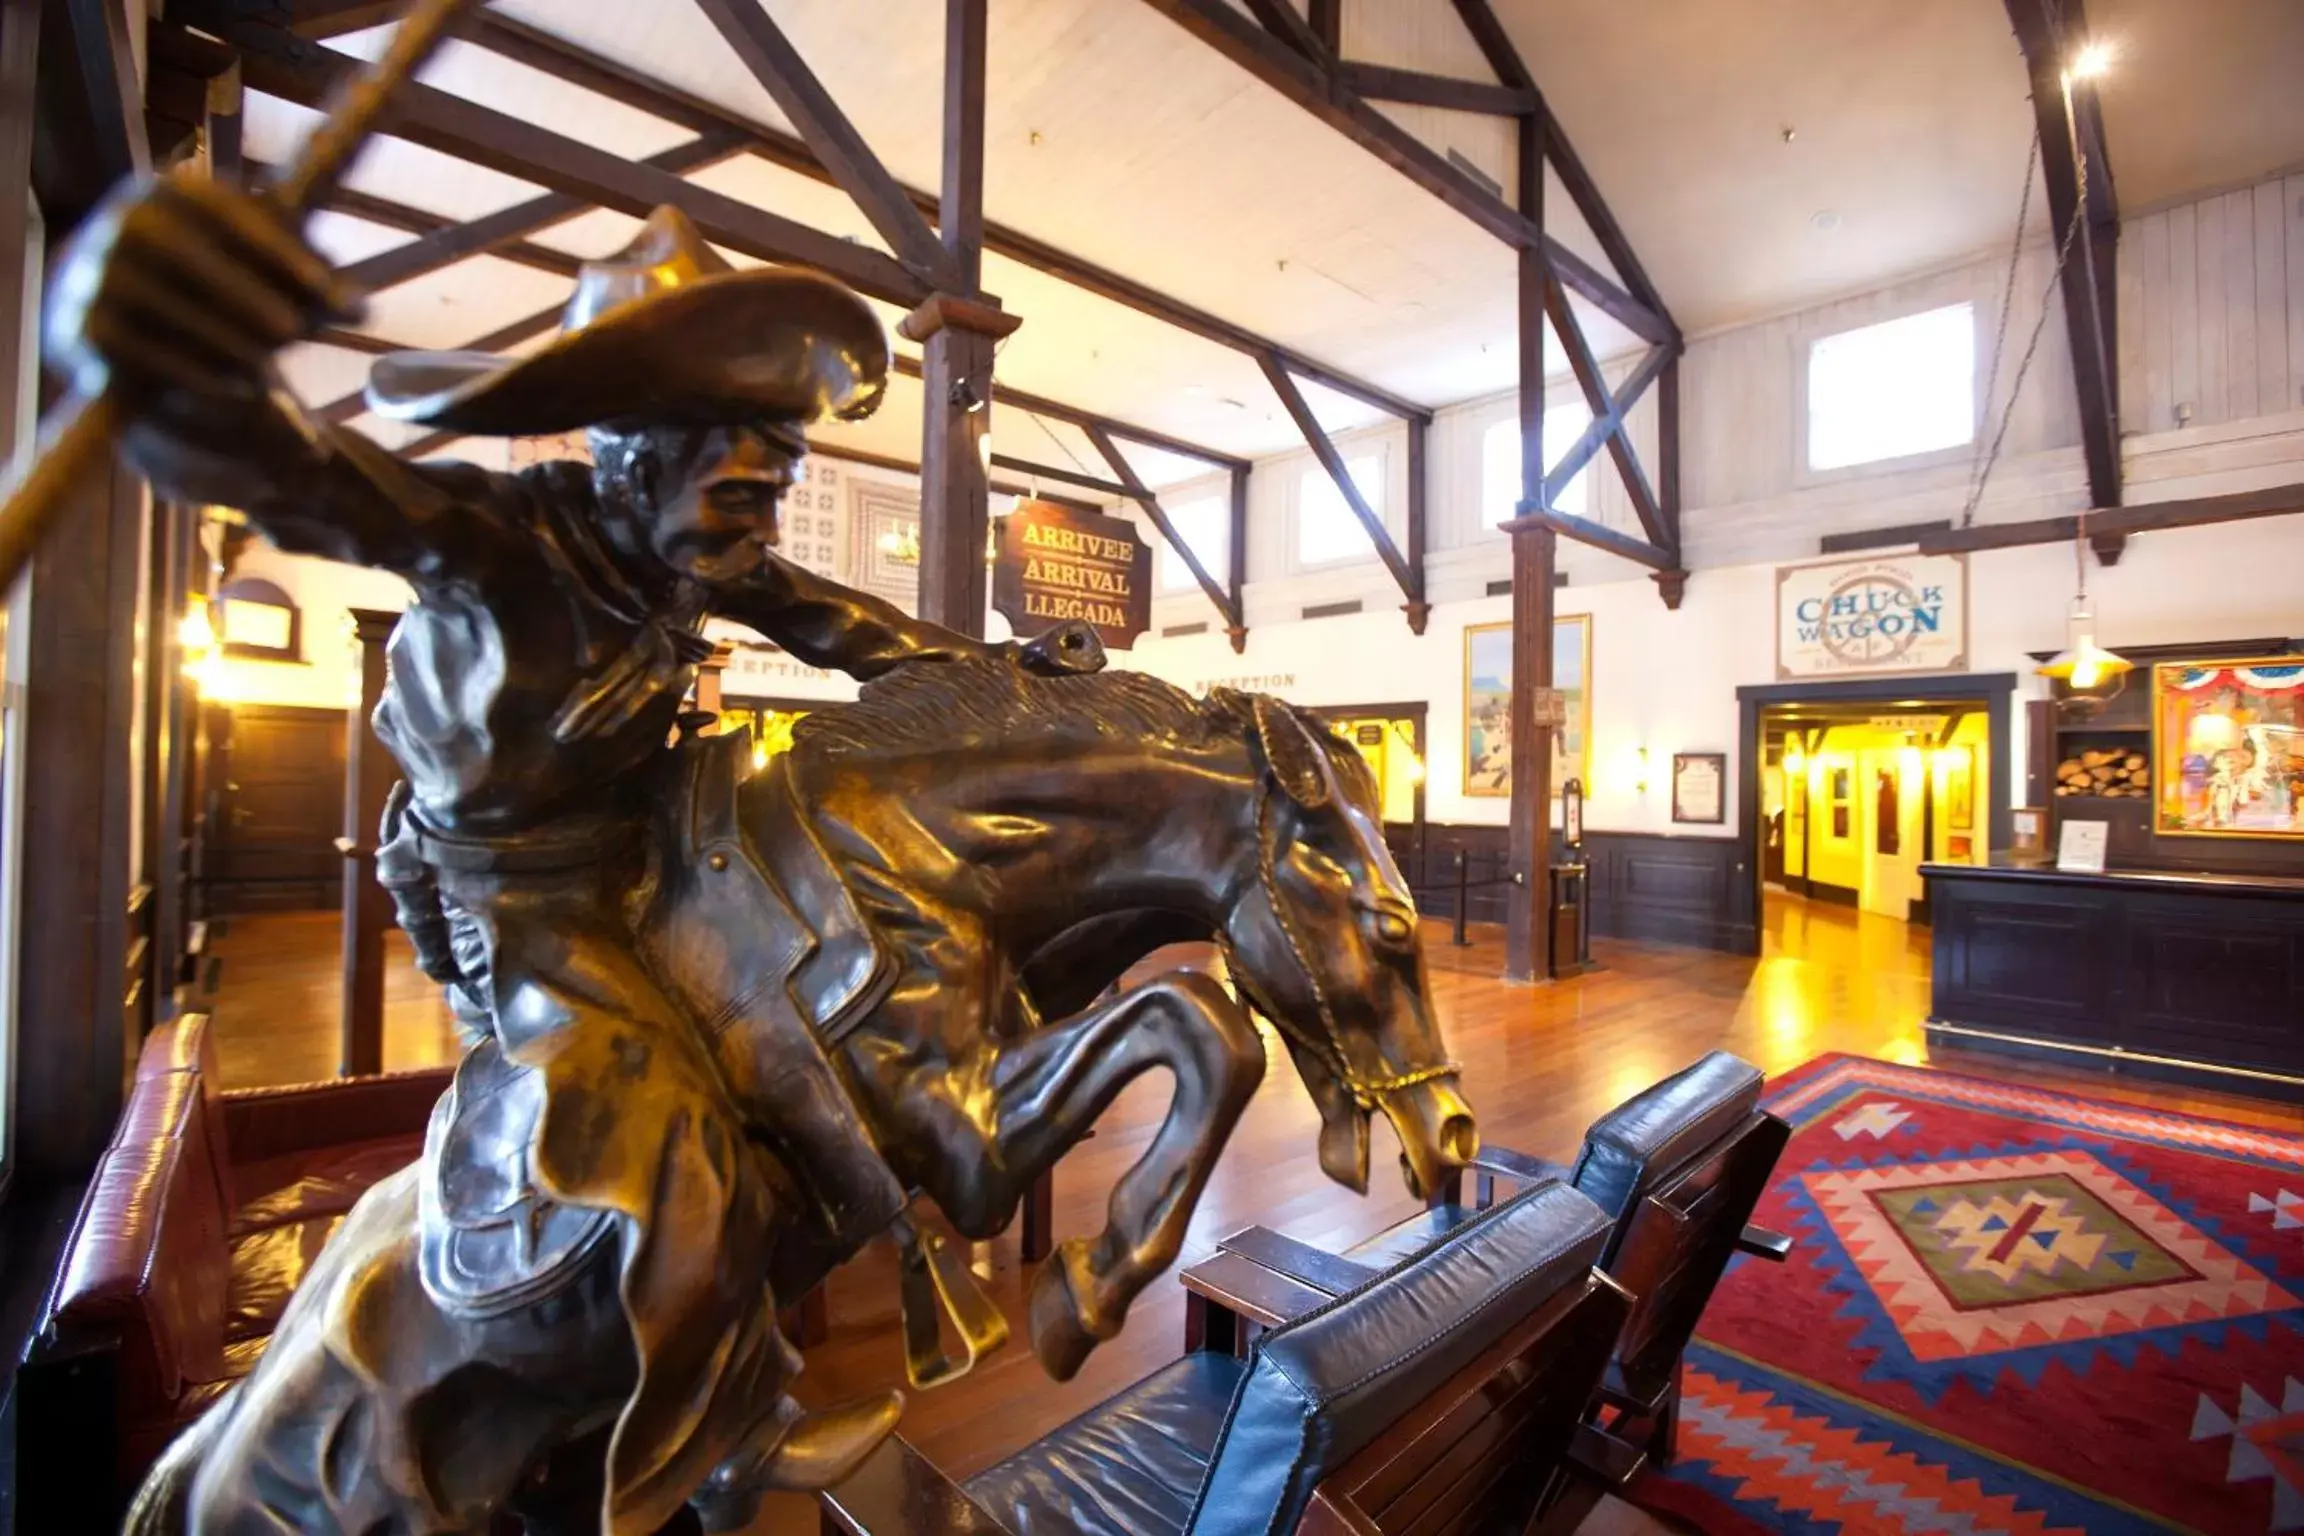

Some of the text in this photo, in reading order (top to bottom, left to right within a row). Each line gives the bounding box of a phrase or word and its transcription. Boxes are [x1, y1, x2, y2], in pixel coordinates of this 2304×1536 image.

[1022, 524, 1133, 561] ARRIVEE
[1022, 559, 1130, 595] ARRIVAL
[1024, 593, 1126, 627] LLEGADA
[1797, 587, 1942, 622] CHUCK
[1797, 605, 1942, 643] WAGON
